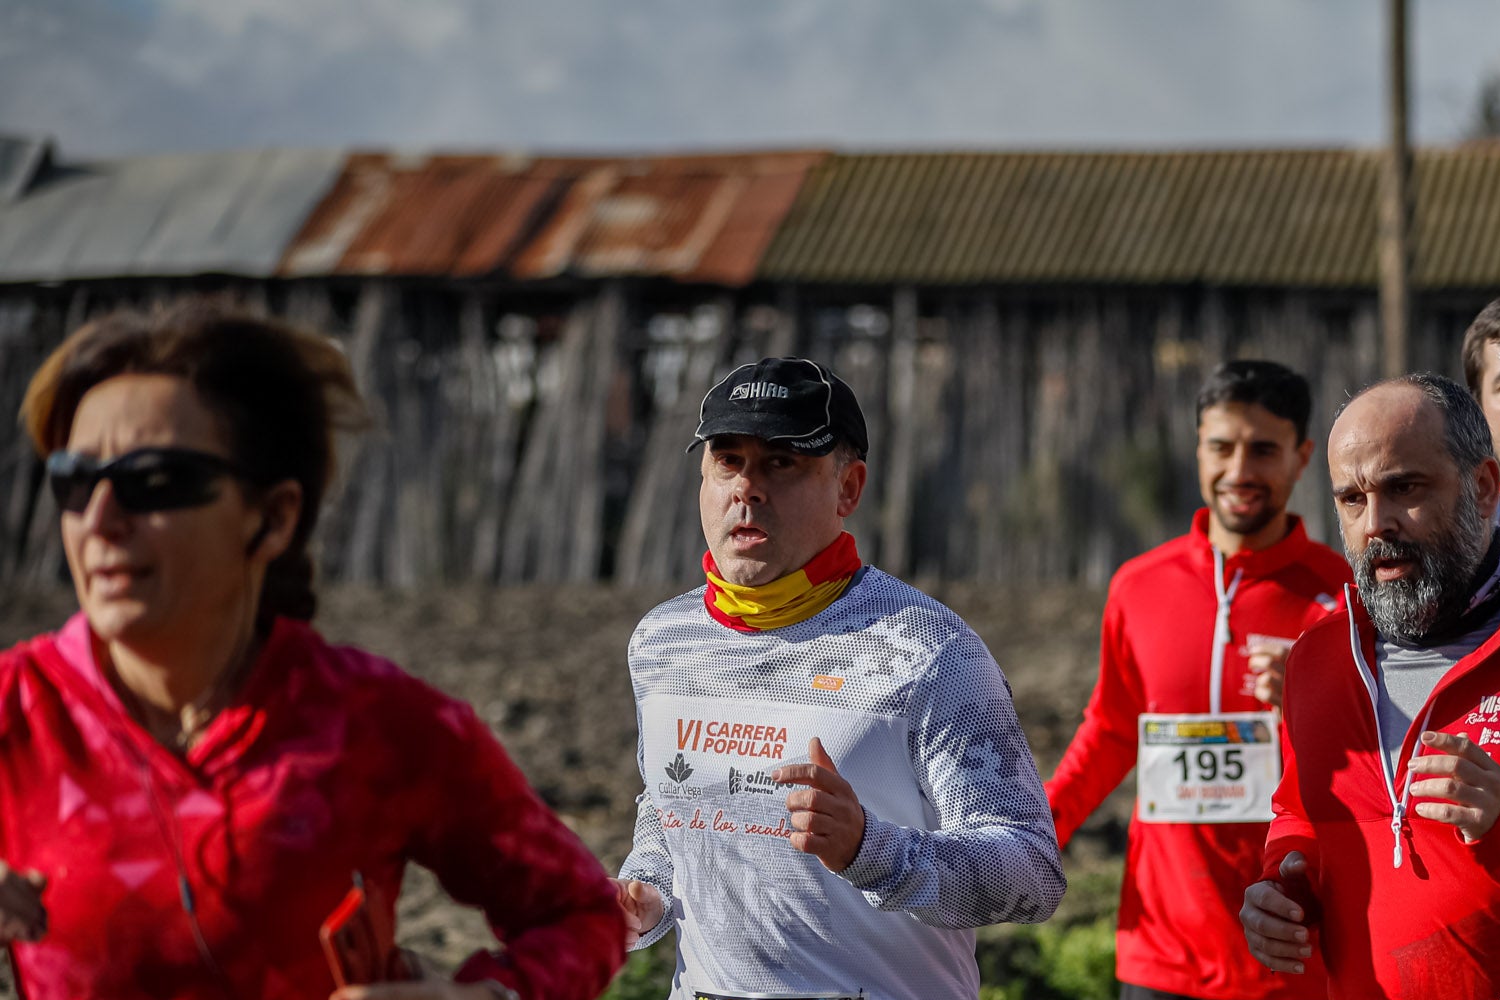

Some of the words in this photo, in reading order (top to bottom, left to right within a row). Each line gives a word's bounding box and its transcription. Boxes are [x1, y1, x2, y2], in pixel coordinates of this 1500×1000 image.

[750, 382, 788, 398] HIAB
[1479, 696, 1497, 714] VII
[1465, 712, 1486, 724] Ruta
[1488, 712, 1498, 722] de
[677, 718, 702, 750] VI
[706, 722, 787, 742] CARRERA
[703, 738, 784, 759] POPULAR
[1173, 750, 1244, 782] 195
[658, 782, 680, 794] Cúllar
[682, 784, 702, 798] Vega
[744, 786, 774, 795] deportes
[690, 809, 706, 830] de
[713, 810, 738, 832] los
